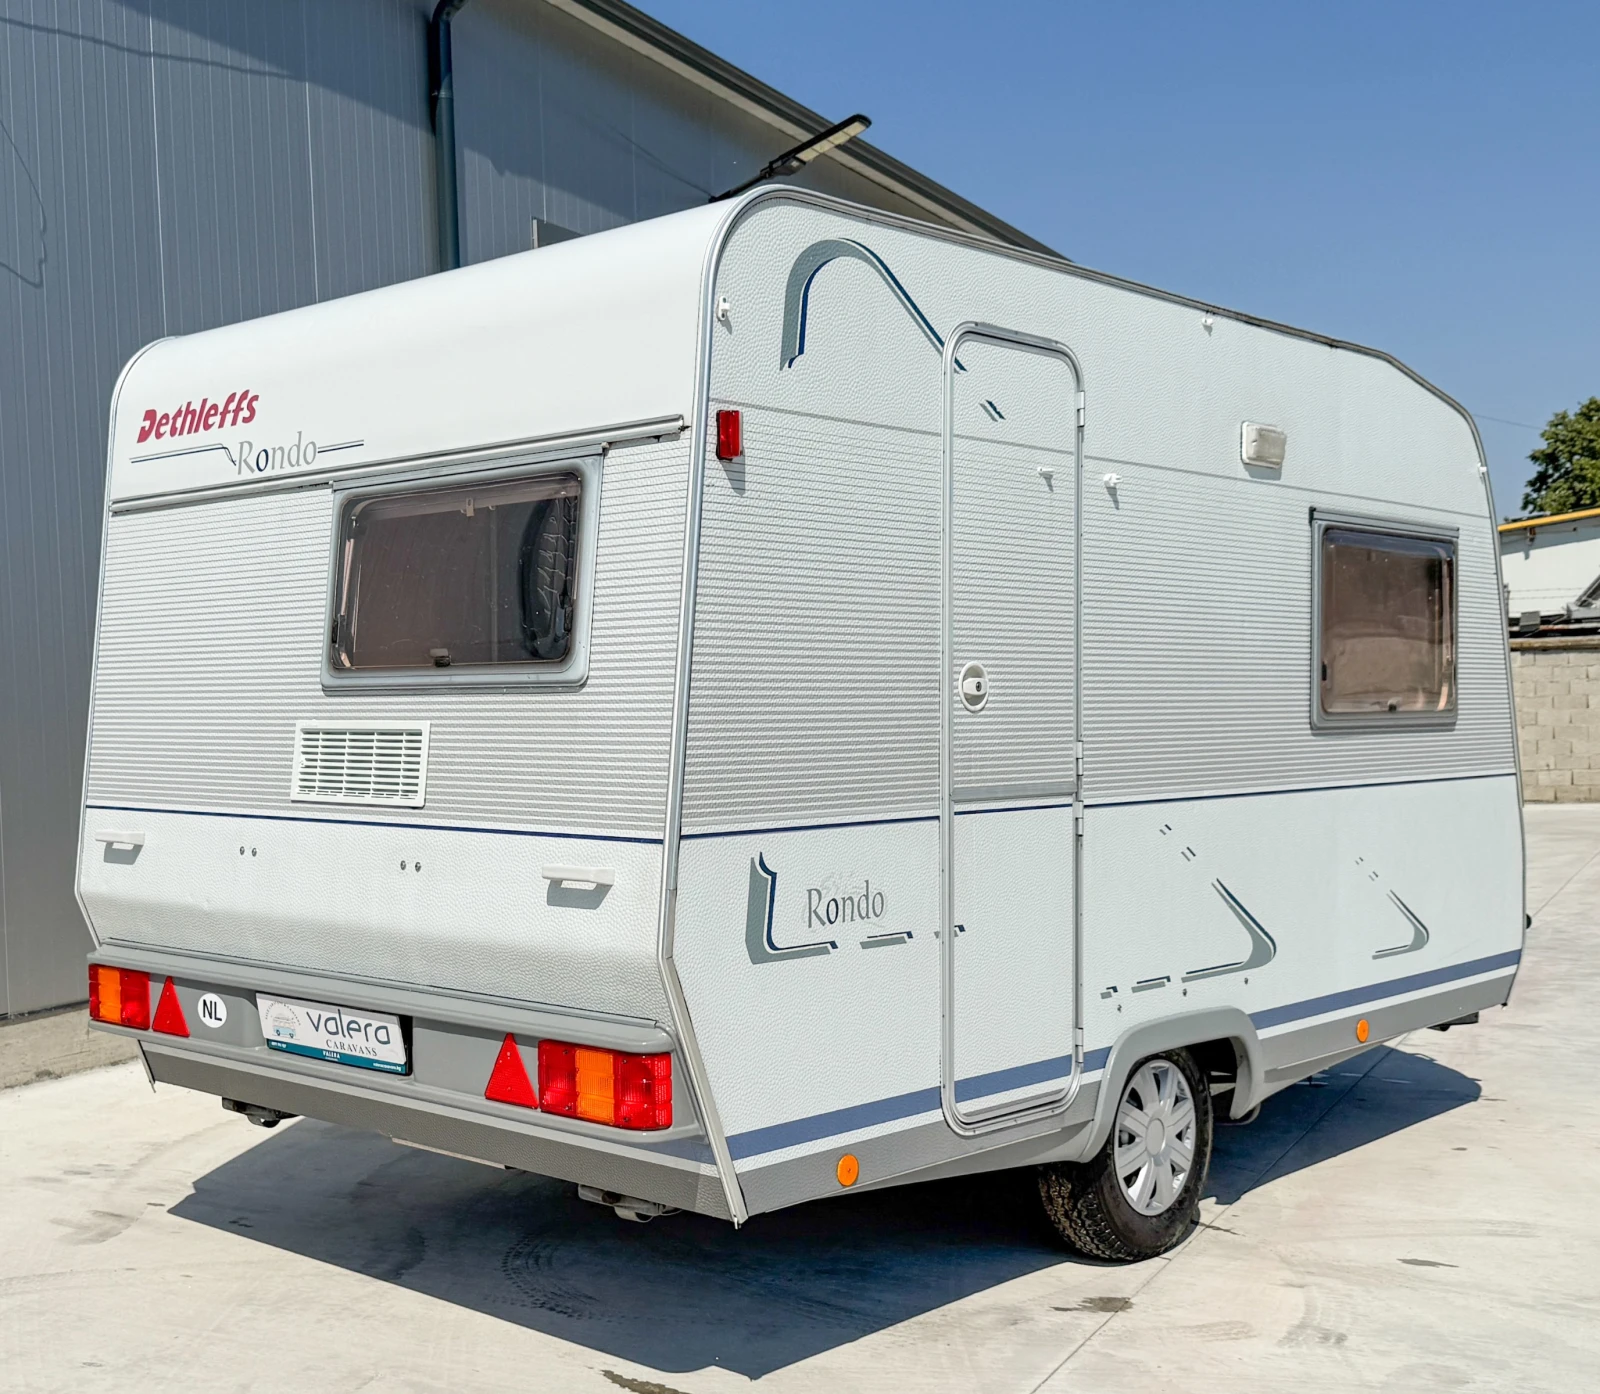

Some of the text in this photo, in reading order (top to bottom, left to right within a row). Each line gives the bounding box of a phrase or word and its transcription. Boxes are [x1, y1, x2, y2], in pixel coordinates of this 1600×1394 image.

[136, 389, 259, 443] Dethleffs
[237, 430, 317, 476] Rondo
[806, 879, 885, 929] Rondo
[202, 998, 223, 1023] NL
[322, 1050, 341, 1059] VALERA
[326, 1038, 378, 1057] CARAVANS
